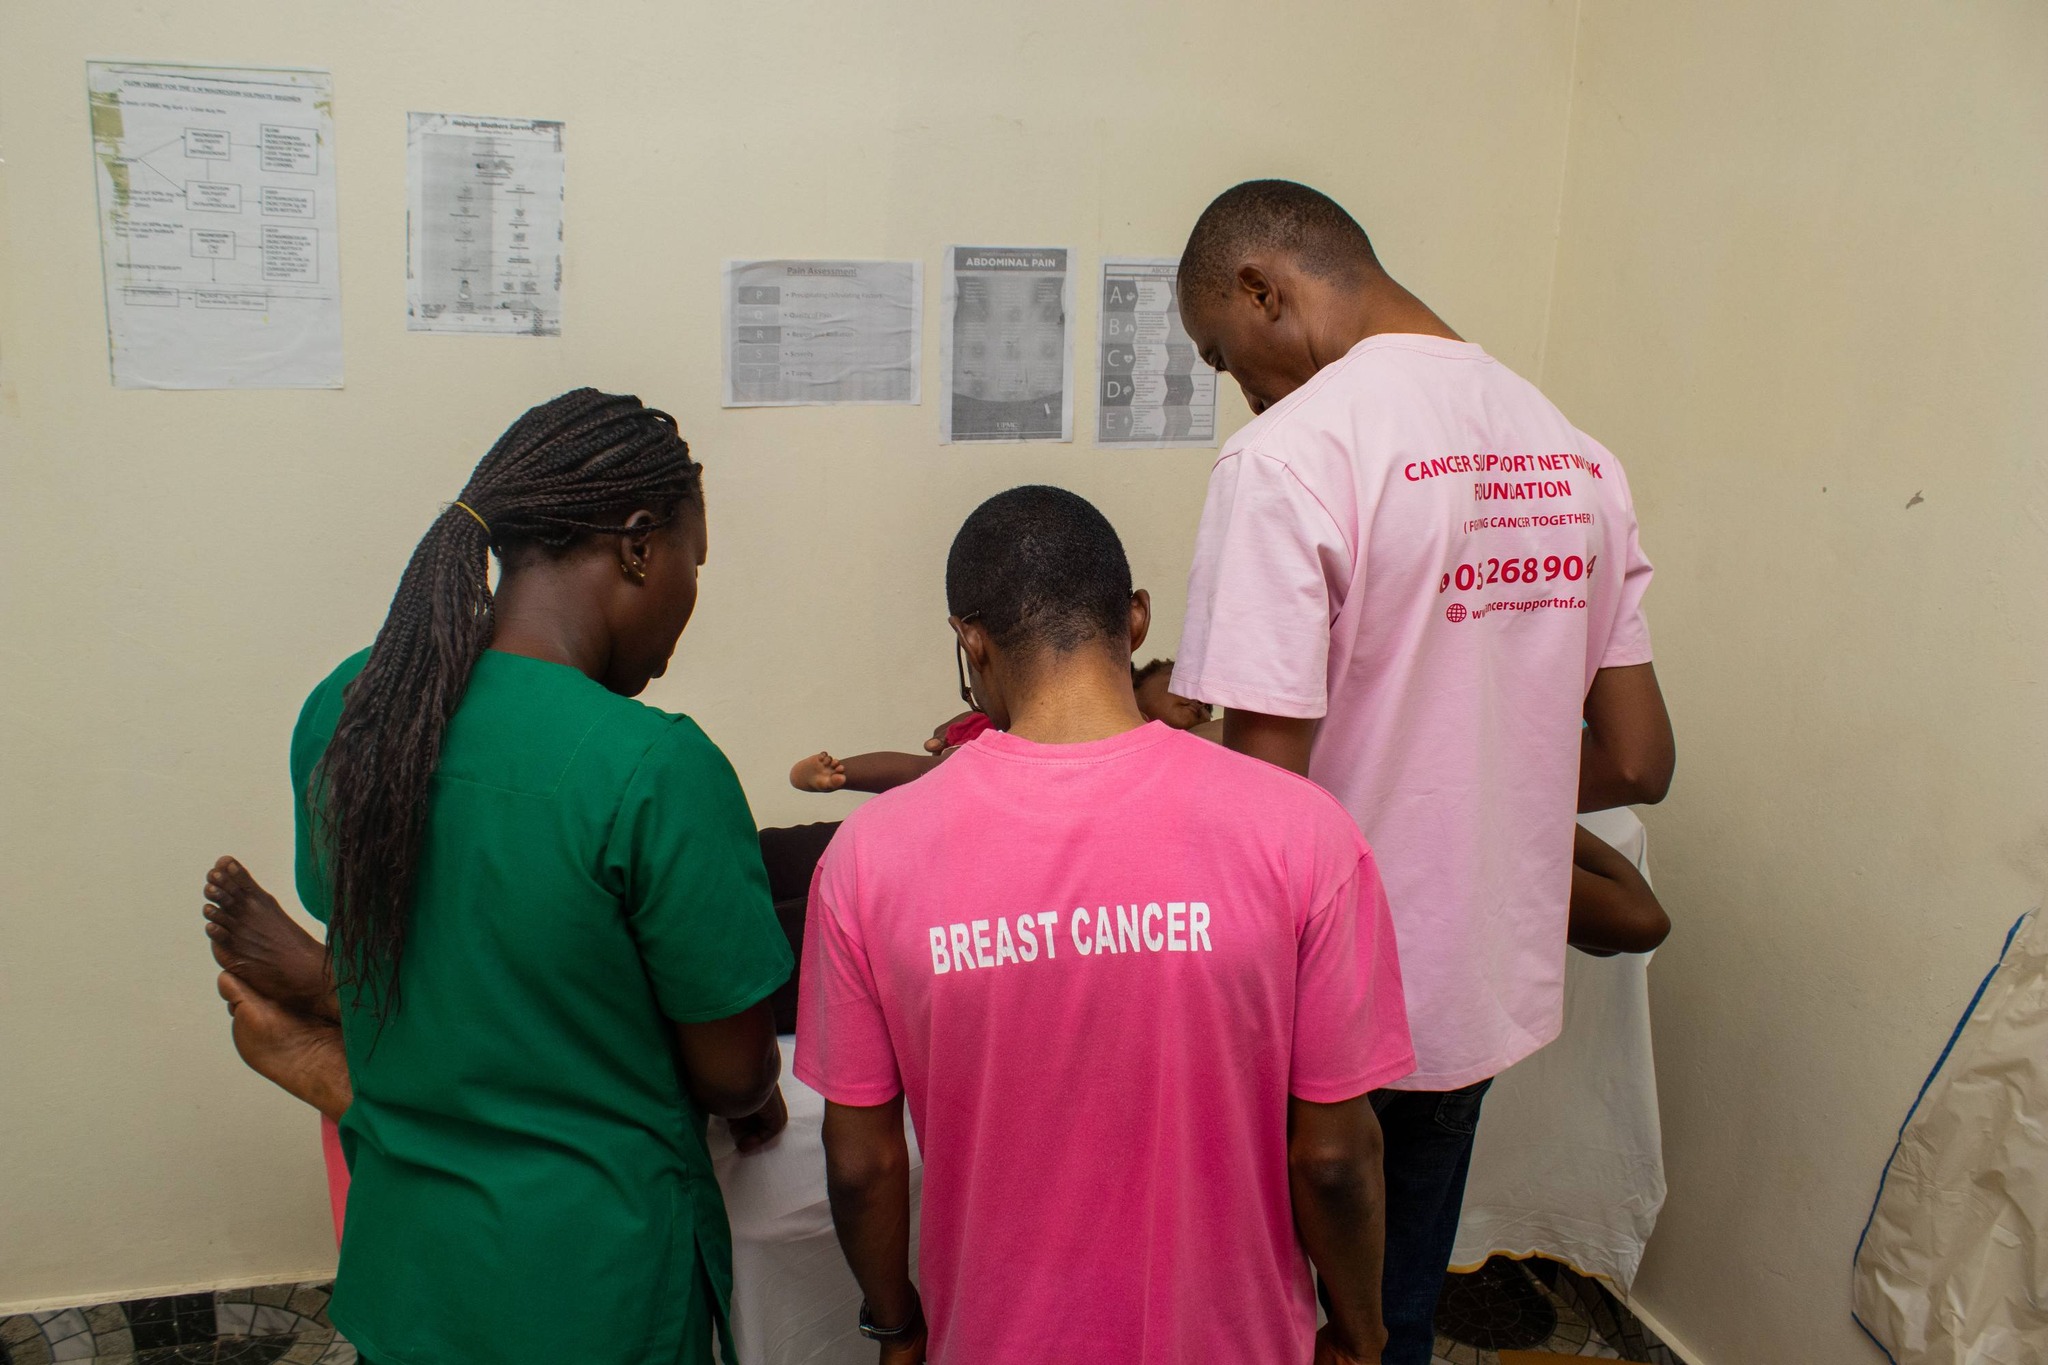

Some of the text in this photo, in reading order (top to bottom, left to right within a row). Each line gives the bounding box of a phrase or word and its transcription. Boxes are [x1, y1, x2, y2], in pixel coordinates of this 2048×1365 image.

[965, 257, 1056, 268] ABDOMINAL PAIN
[786, 266, 857, 278] Pain Assessment
[1109, 286, 1123, 304] A
[756, 329, 764, 339] R
[1109, 318, 1120, 336] B
[1107, 350, 1120, 367] C
[1107, 381, 1121, 398] D
[1106, 412, 1116, 429] E
[1404, 455, 1473, 482] CANCER
[1537, 453, 1603, 479] NETWK
[1474, 480, 1572, 501] FOUNDATION
[1490, 516, 1530, 528] CANCER
[1531, 513, 1591, 527] TOGETHER
[929, 902, 1213, 975] BREAST CANCER
